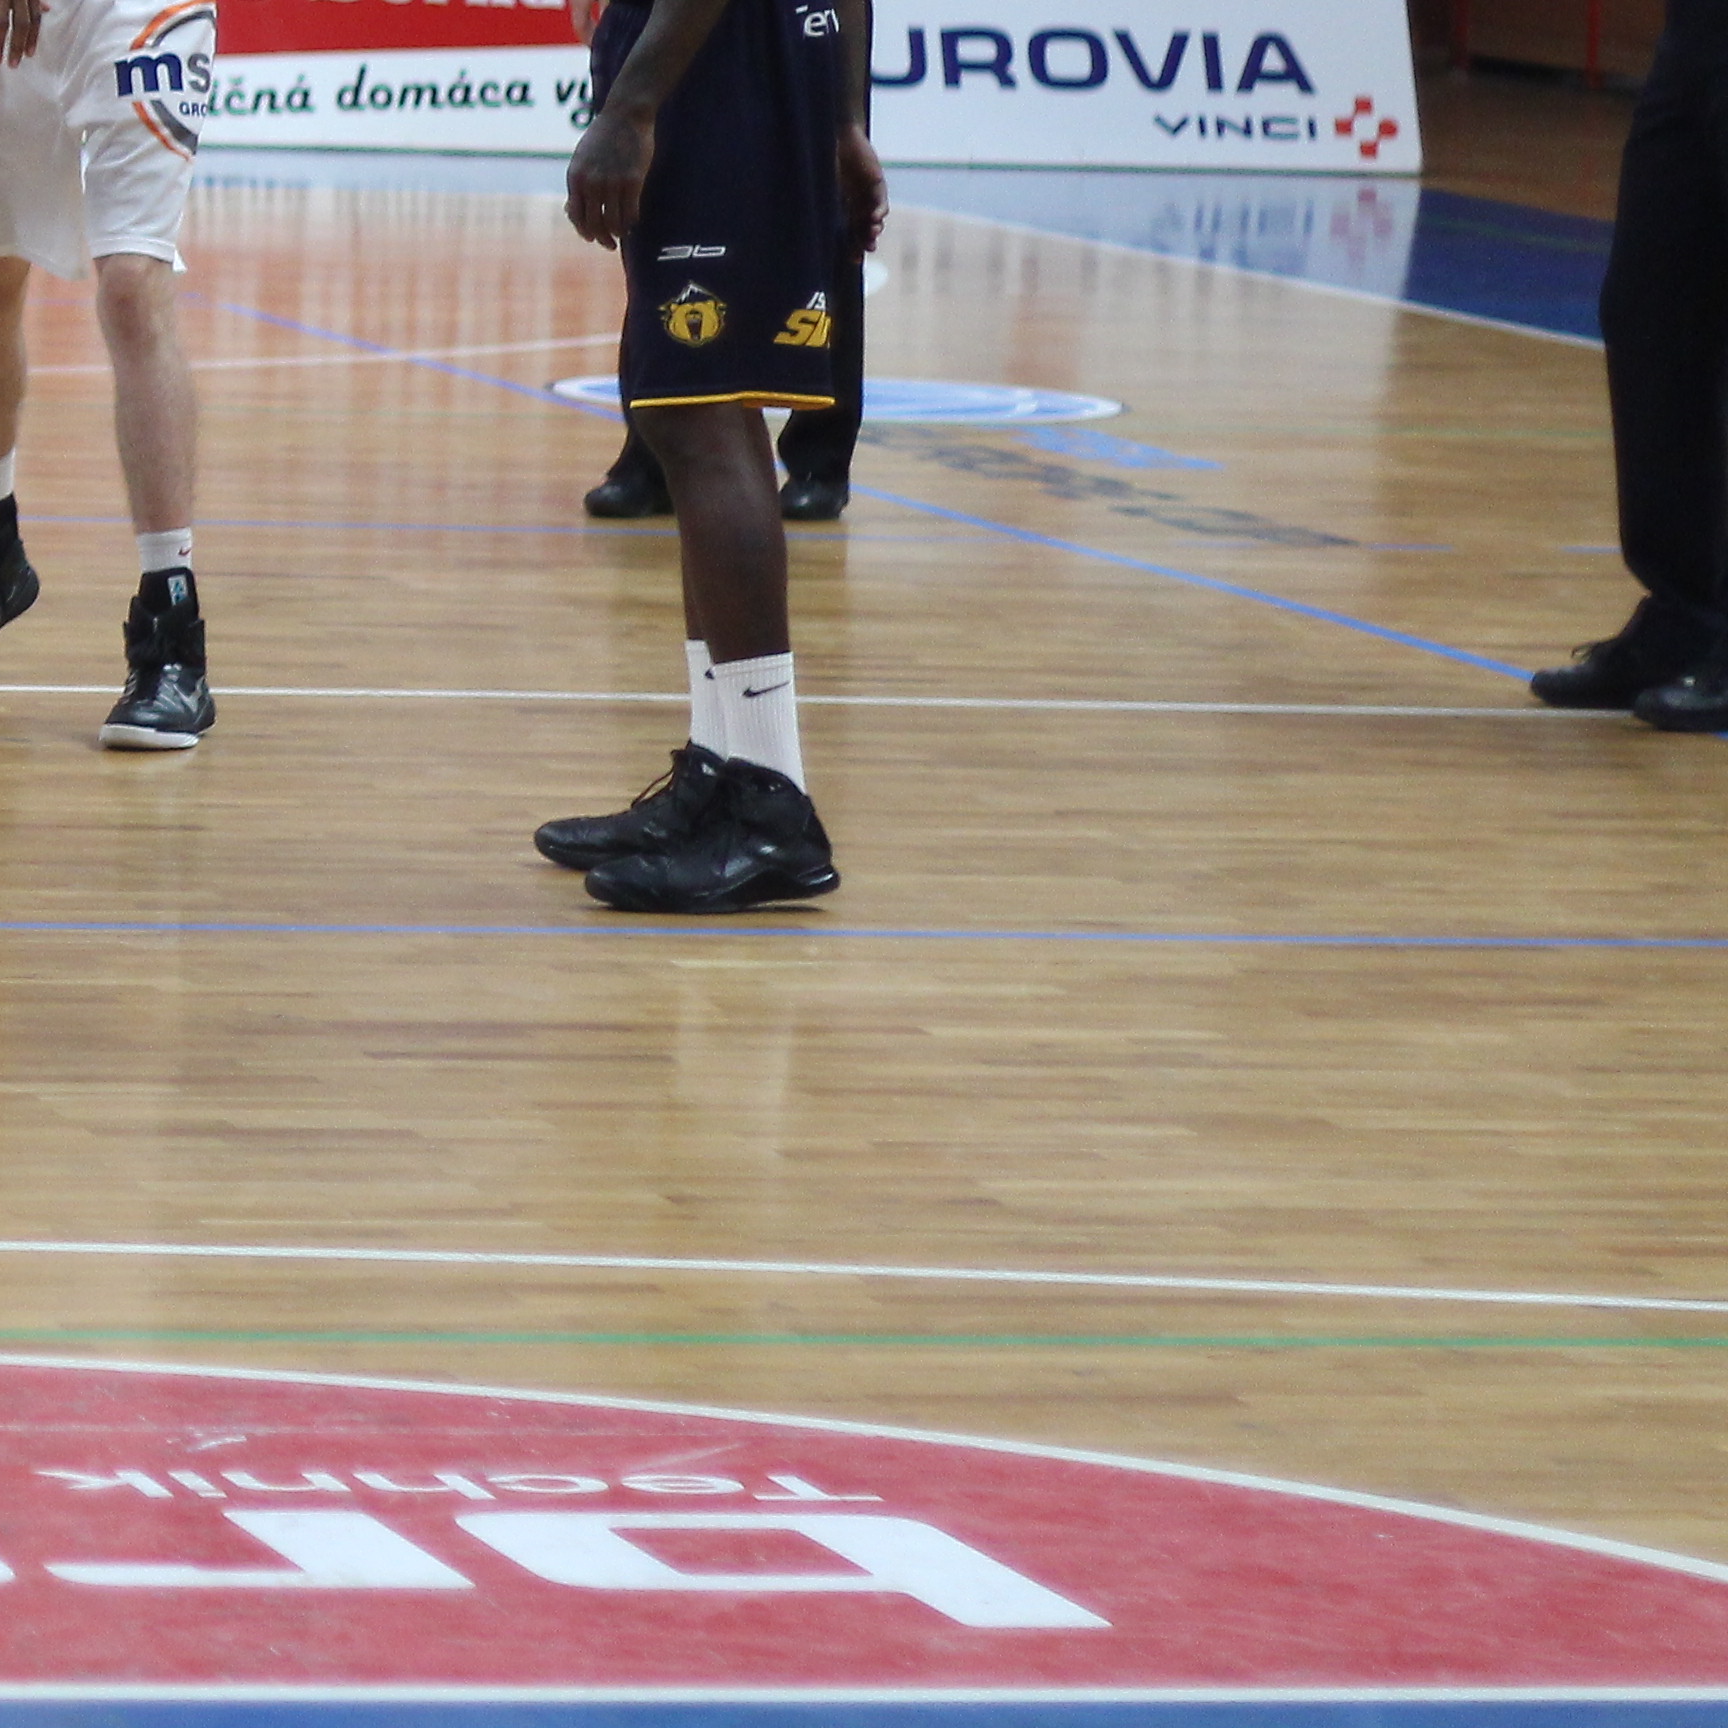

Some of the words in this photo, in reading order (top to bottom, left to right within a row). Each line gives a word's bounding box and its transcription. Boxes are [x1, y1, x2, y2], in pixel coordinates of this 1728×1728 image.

[871, 26, 1317, 95] UROVIA
[336, 62, 536, 113] domáca
[1153, 113, 1318, 143] VINCI
